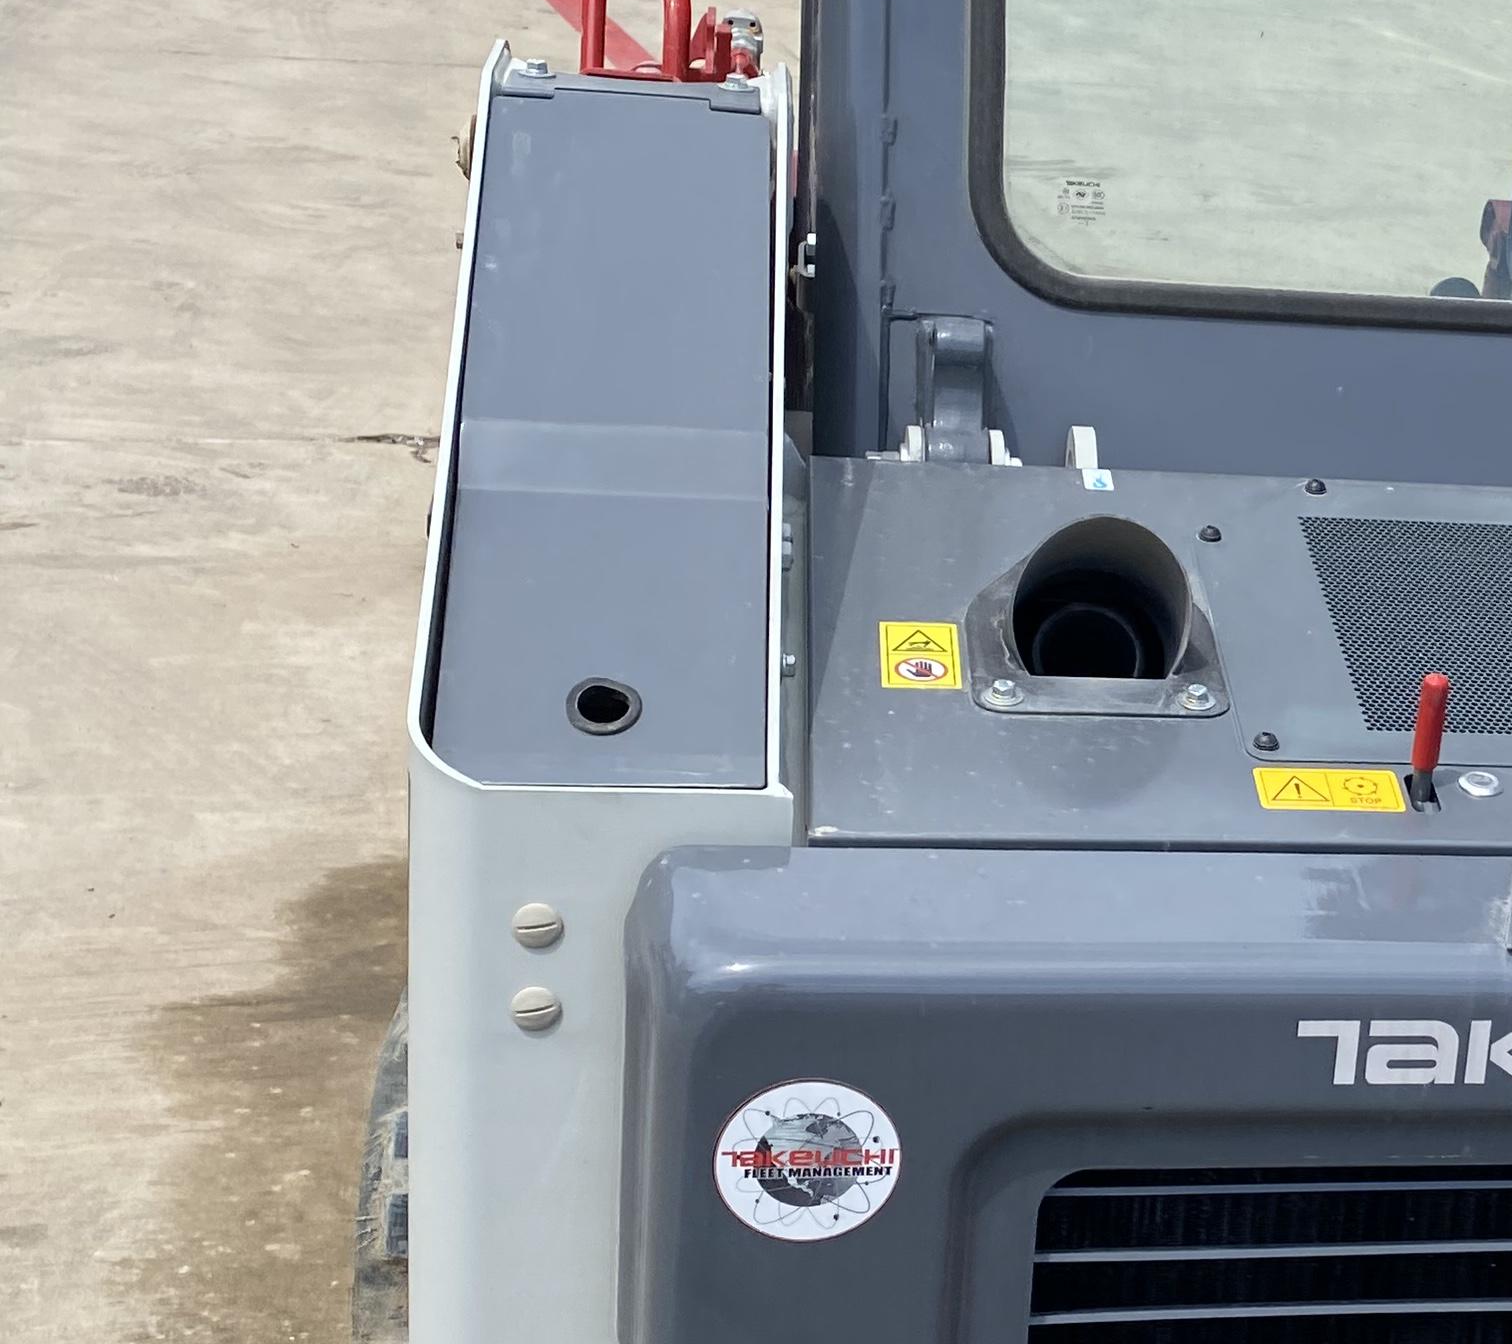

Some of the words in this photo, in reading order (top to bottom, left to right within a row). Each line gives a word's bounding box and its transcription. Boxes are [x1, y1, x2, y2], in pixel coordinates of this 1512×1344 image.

[1350, 797, 1382, 805] STOP
[743, 1167, 785, 1179] FLEET
[788, 1166, 893, 1178] MANAGEMENT
